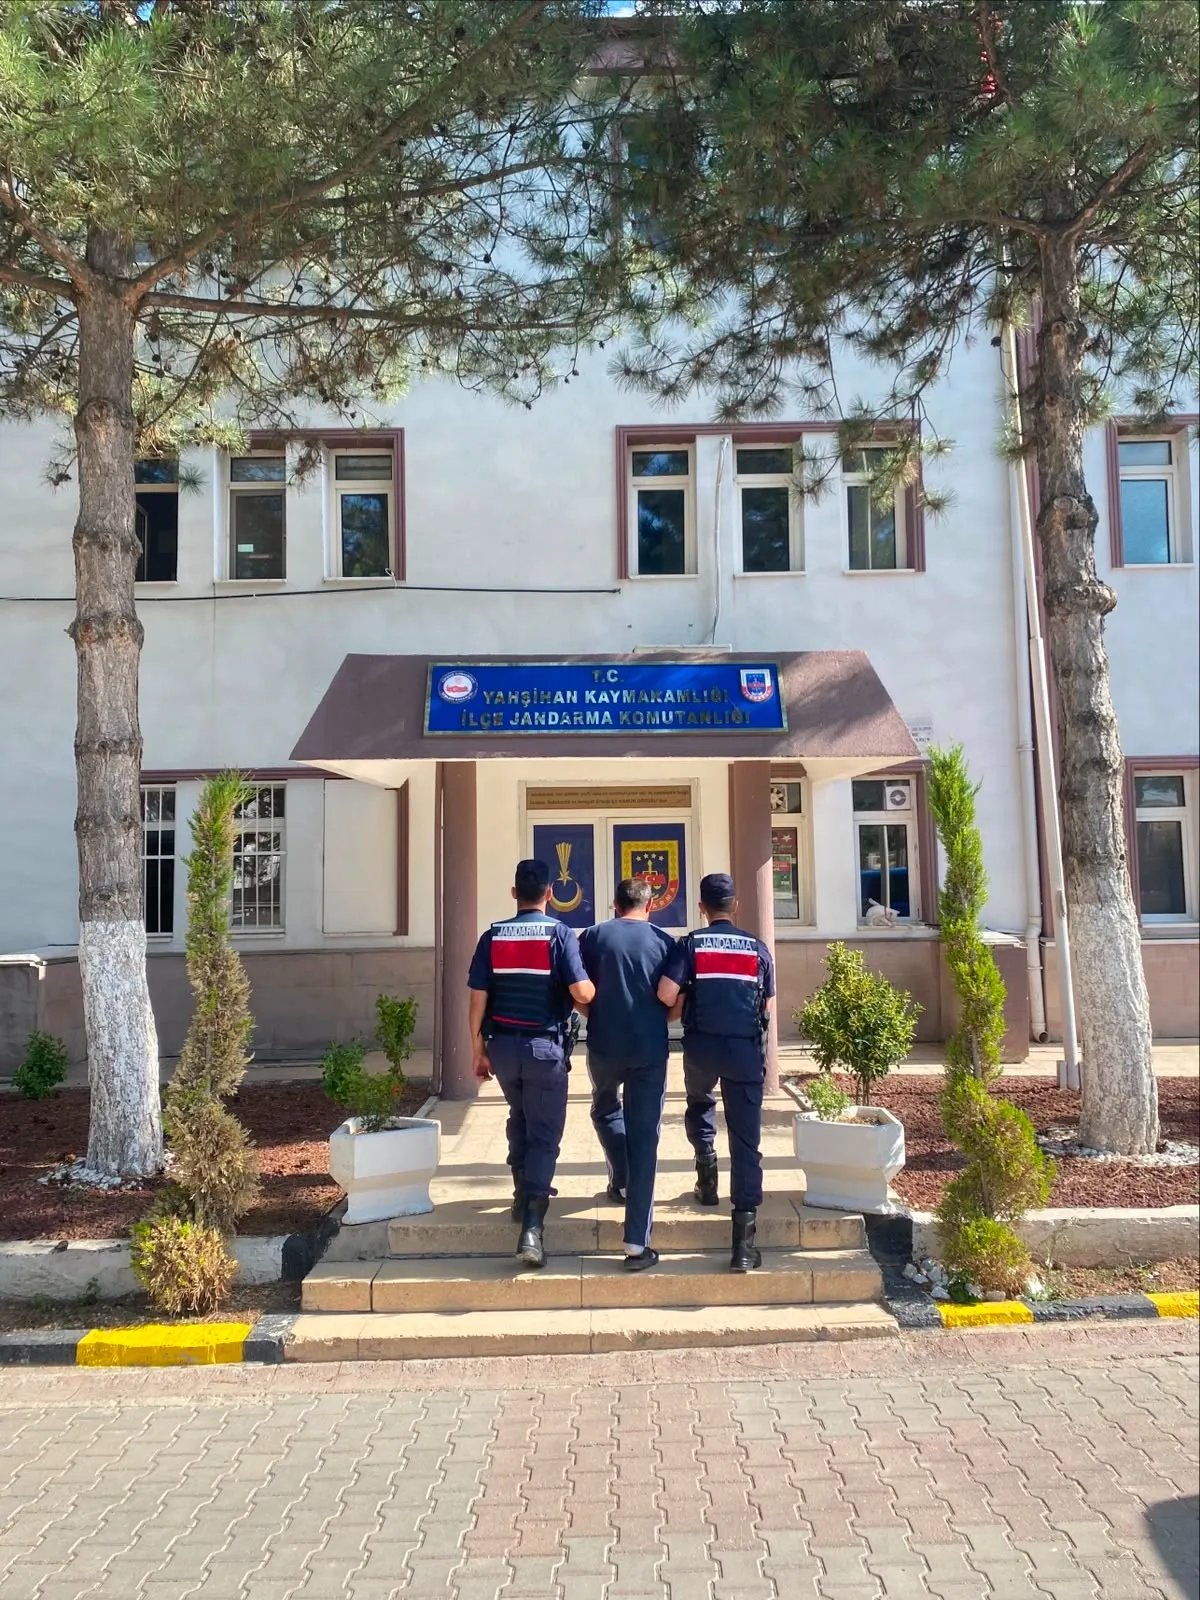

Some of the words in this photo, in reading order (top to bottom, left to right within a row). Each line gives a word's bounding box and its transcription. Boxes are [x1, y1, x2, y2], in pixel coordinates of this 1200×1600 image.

[483, 687, 578, 707] YAHŞİHAN
[585, 686, 729, 704] KAYMAKAMLIĞI
[461, 709, 503, 729] İLÇE
[510, 711, 613, 726] JANDARMA
[619, 706, 750, 725] KOMUTANLIĞI
[497, 925, 546, 937] JANDARMA
[700, 936, 752, 951] JANDARMA
